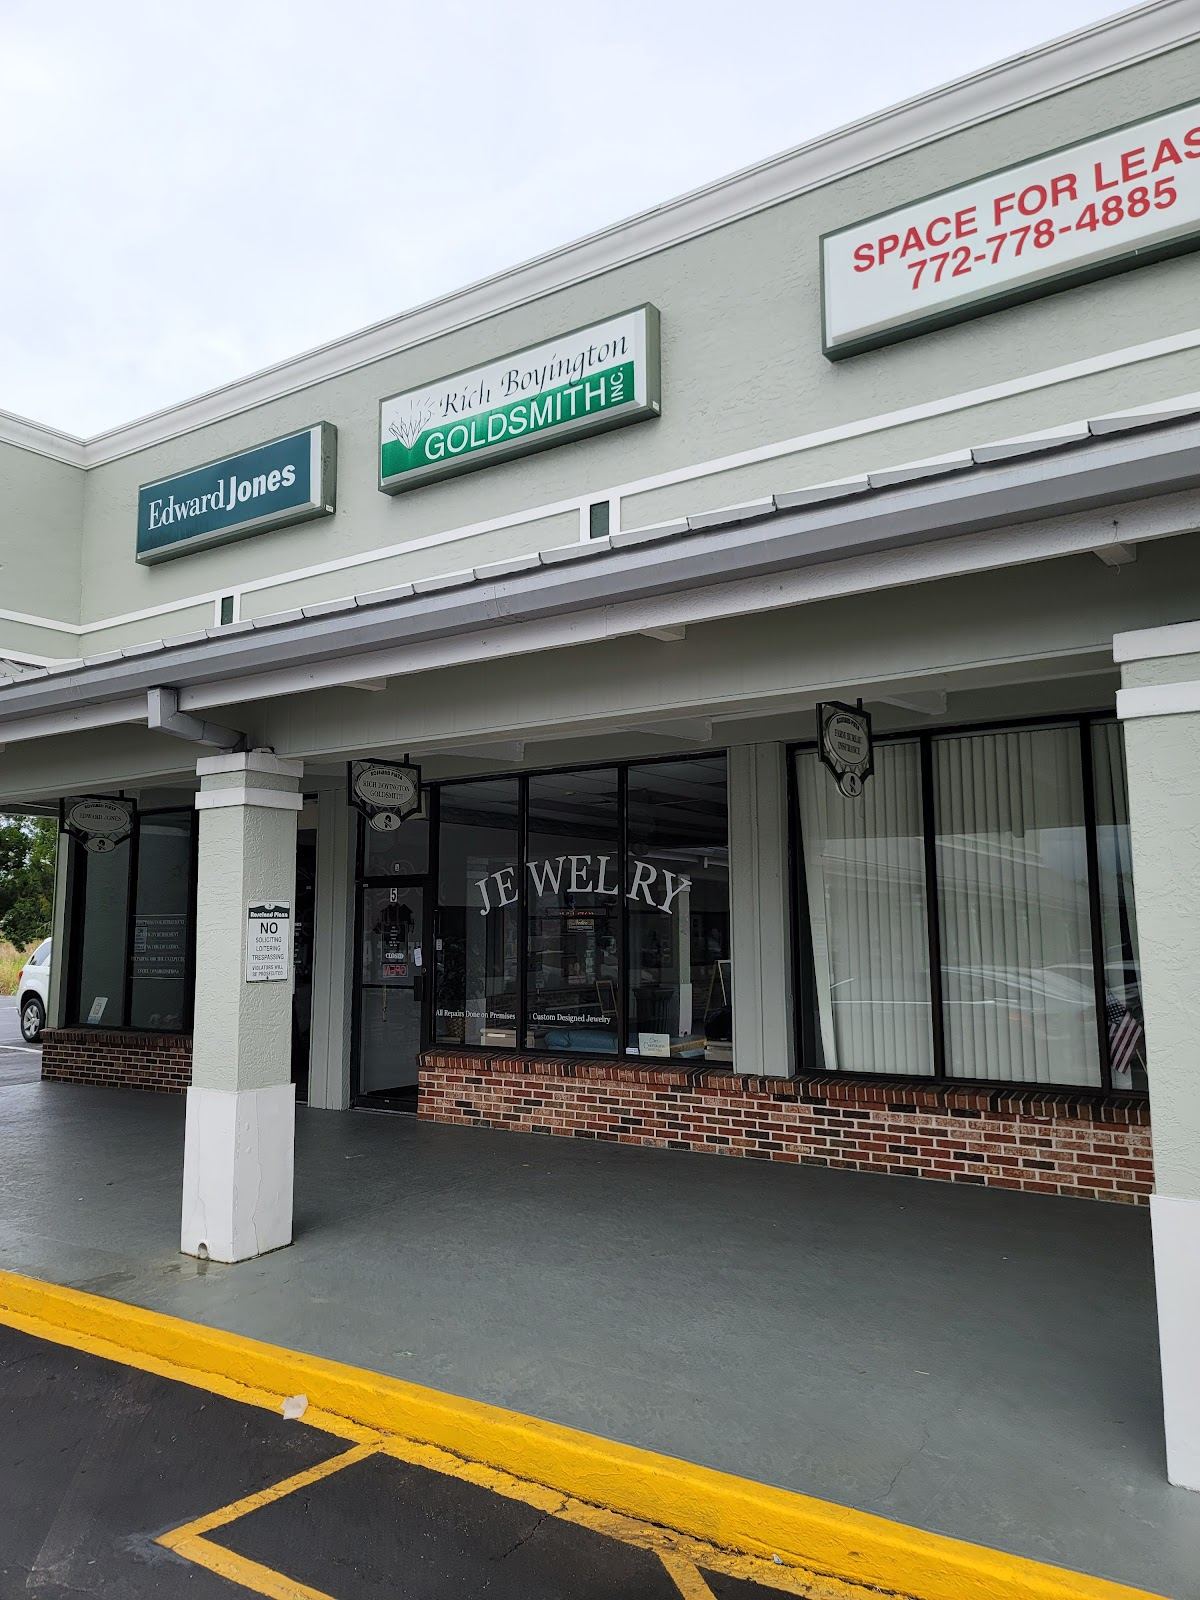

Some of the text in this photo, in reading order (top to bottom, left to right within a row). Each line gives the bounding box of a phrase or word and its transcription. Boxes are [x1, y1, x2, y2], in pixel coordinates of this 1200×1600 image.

[853, 205, 978, 273] SPACE
[993, 173, 1078, 226] FOR
[907, 176, 1177, 290] 772-778-4885
[439, 335, 629, 418] Rich Boyington
[610, 367, 625, 403] INC.
[424, 377, 606, 460] GOLDSMITH
[474, 855, 693, 917] JEWELRY
[260, 922, 278, 934] NO
[435, 1009, 444, 1017] All
[444, 1009, 464, 1019] Repairs
[465, 1010, 481, 1018] Done
[490, 1011, 516, 1020] Premises
[532, 1012, 612, 1025] Custom Designed Jewelry
